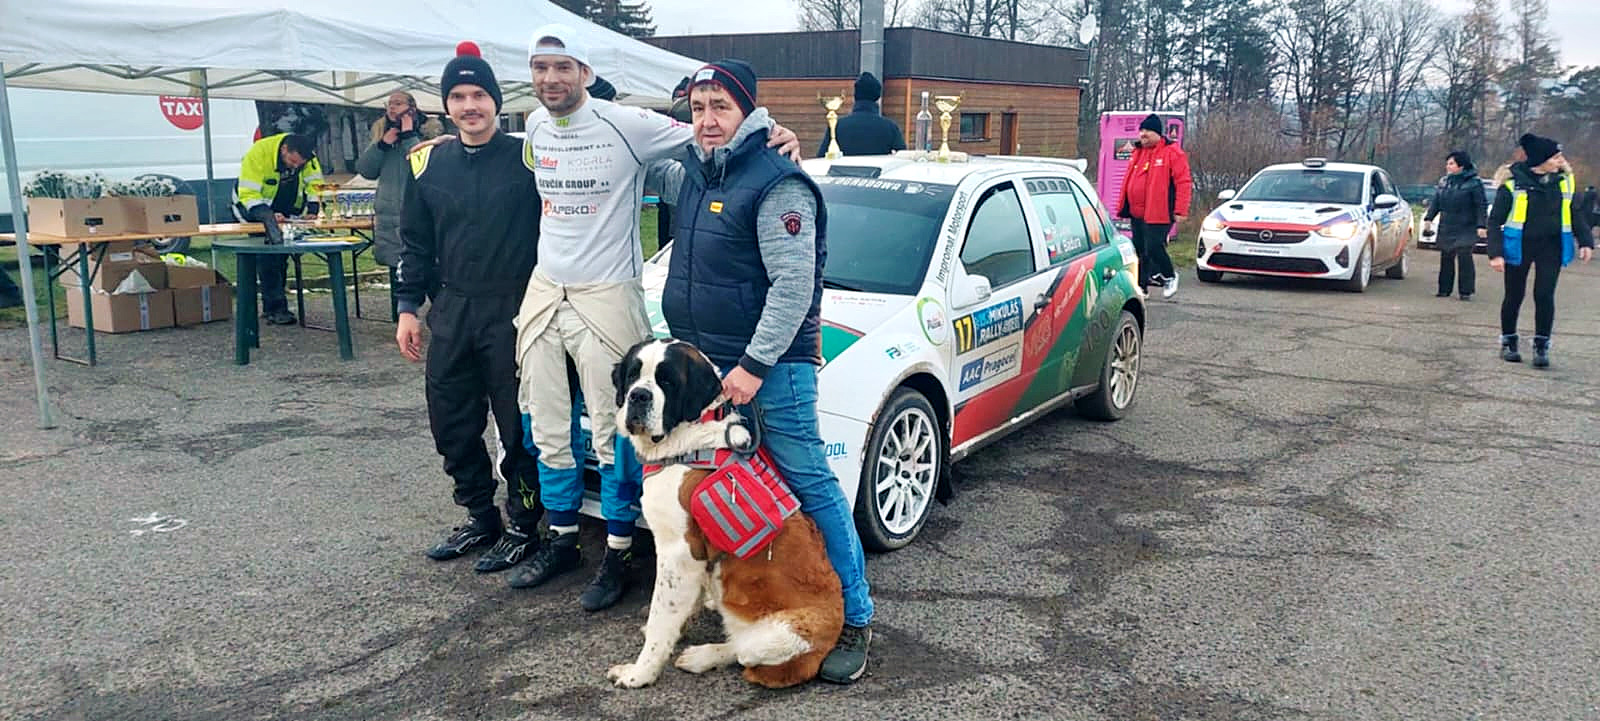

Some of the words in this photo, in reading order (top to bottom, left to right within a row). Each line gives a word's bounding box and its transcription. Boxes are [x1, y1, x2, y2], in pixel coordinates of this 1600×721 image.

[565, 179, 597, 189] GROUP
[936, 236, 955, 284] Impromat
[948, 192, 967, 236] Motorsport
[989, 300, 1019, 322] MIKULÁŠ
[955, 316, 973, 353] 17
[980, 321, 1004, 343] RALLY
[962, 366, 982, 384] AAC
